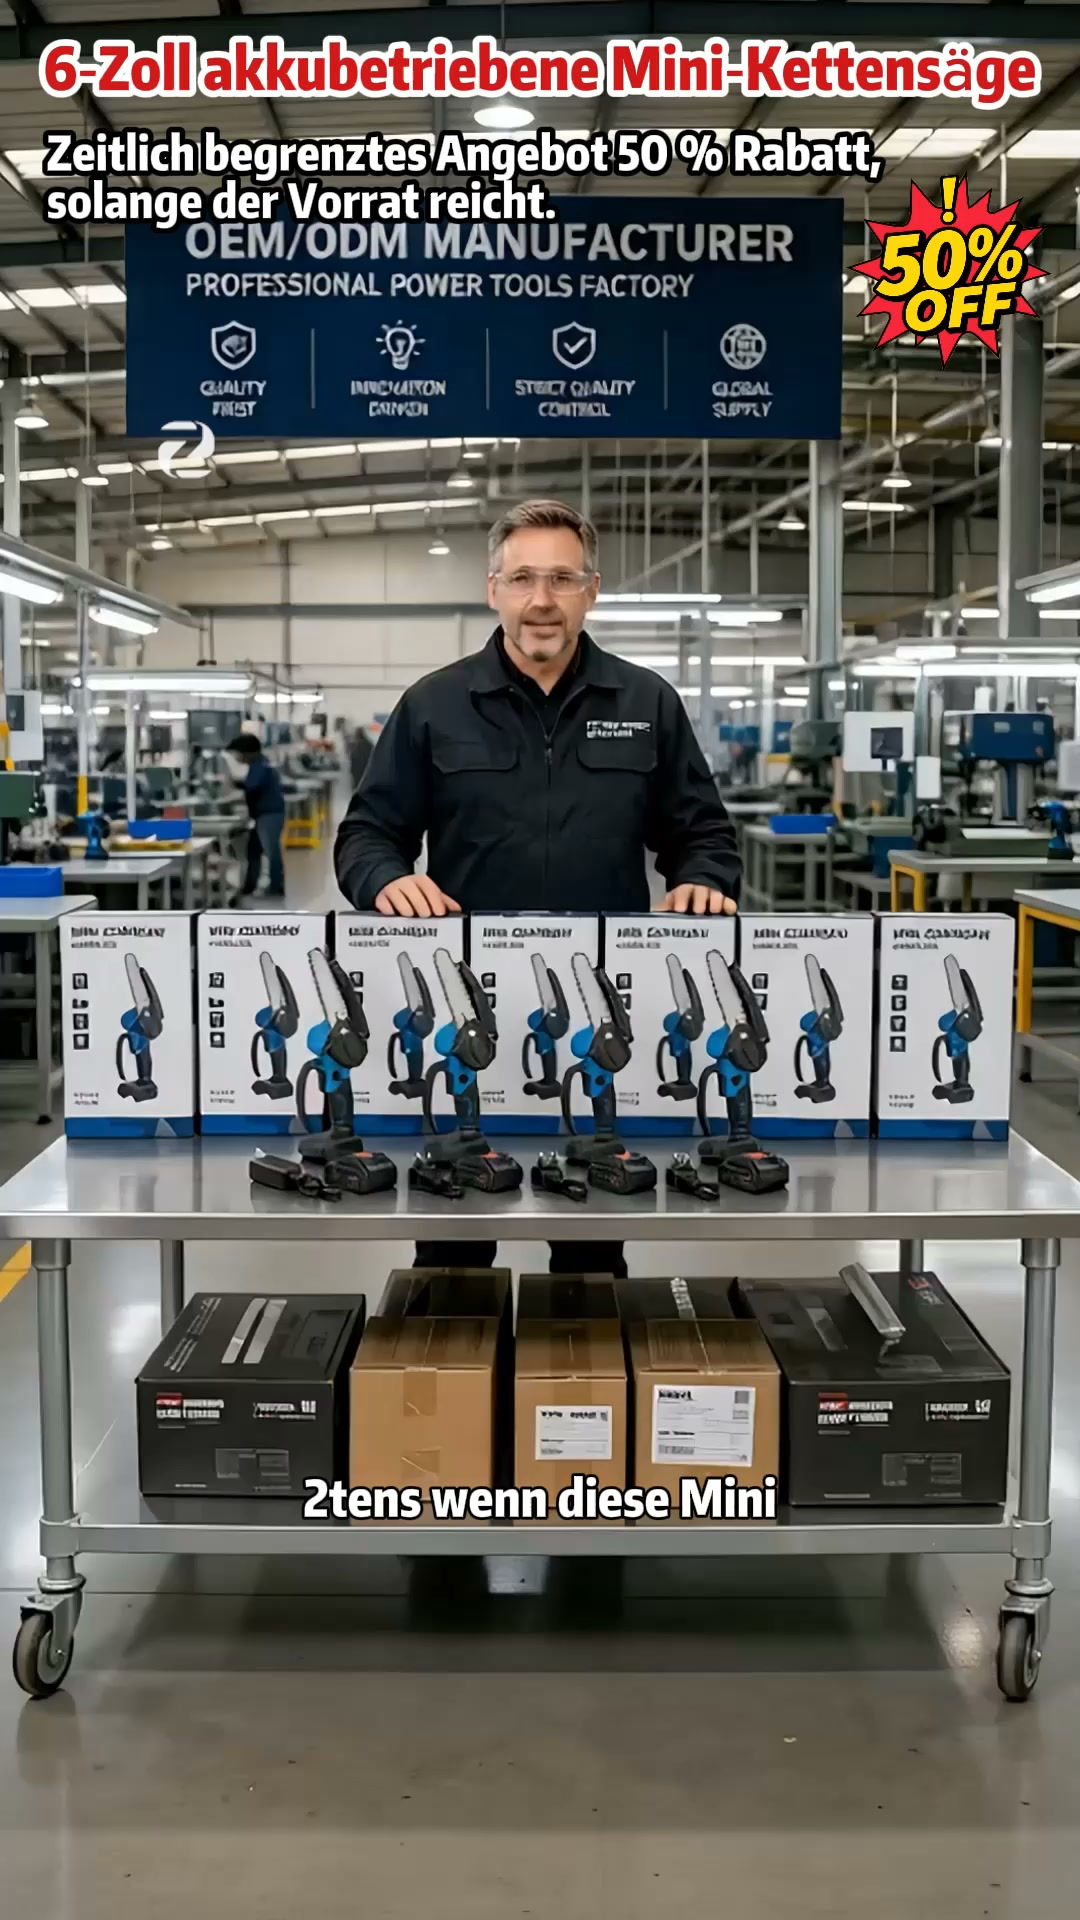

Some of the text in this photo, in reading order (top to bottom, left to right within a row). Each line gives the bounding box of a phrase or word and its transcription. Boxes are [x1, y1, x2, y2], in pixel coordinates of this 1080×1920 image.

[185, 221, 794, 262] OEM/ODM MANUFACTURER
[186, 272, 695, 298] PROFESSIONAL POWER TOOLS FACTORY
